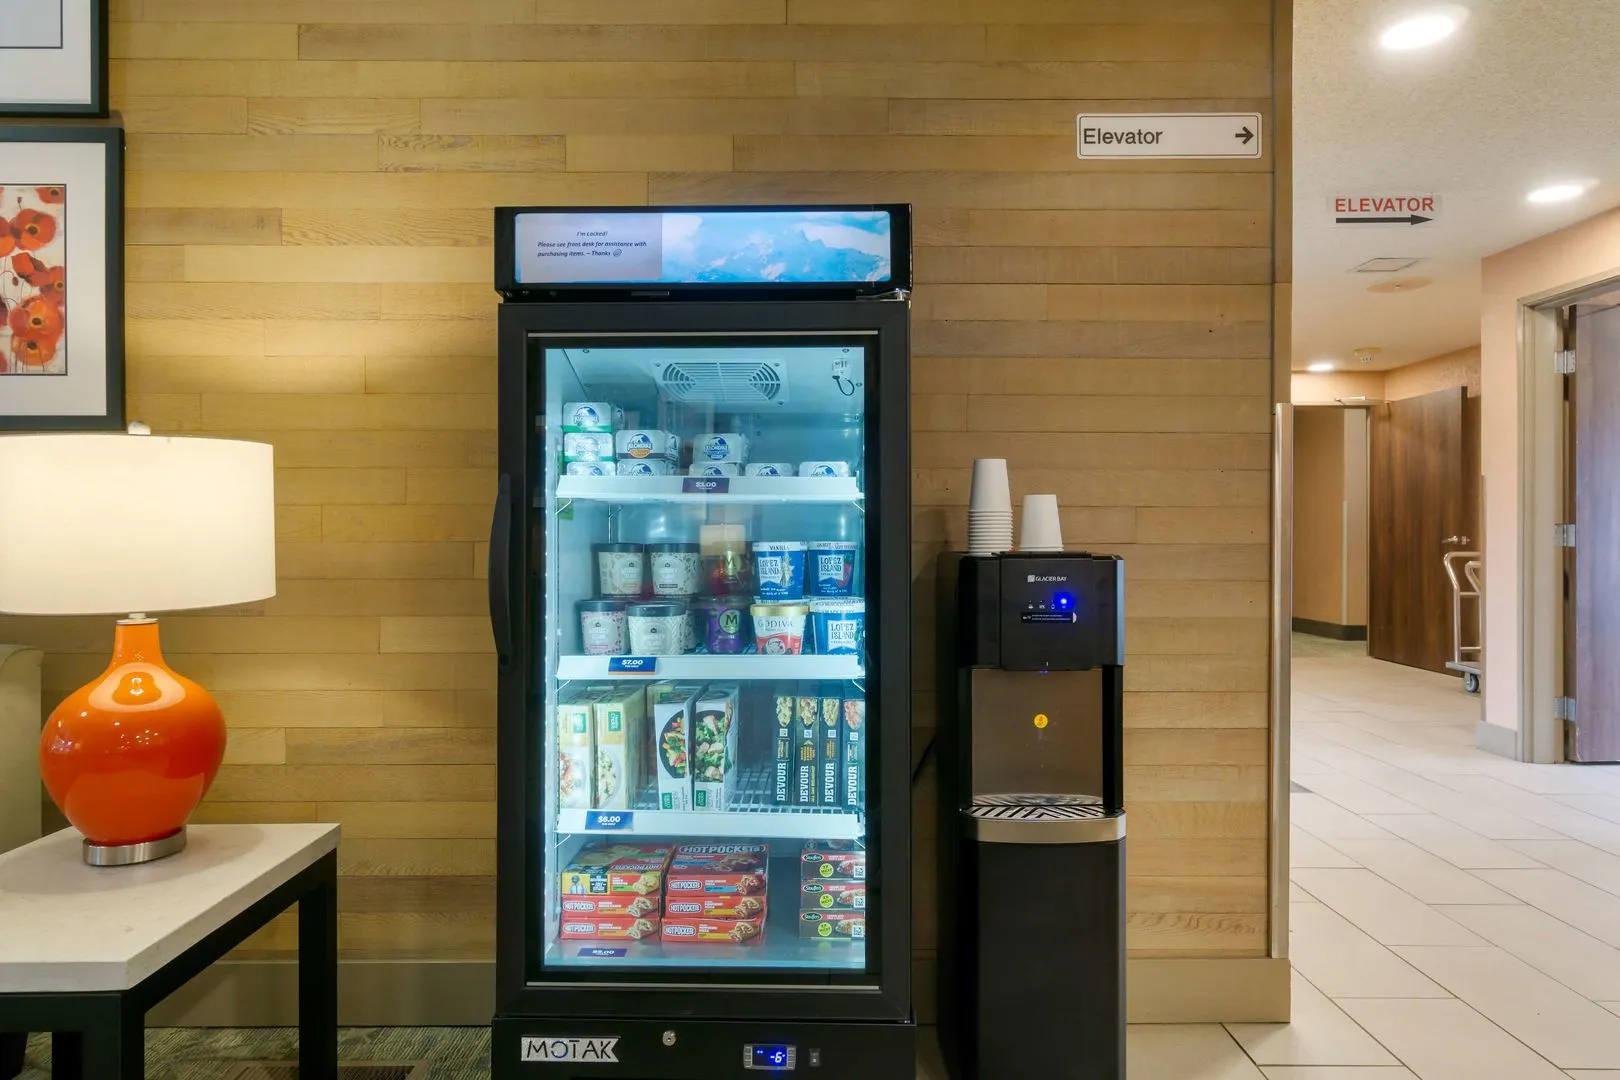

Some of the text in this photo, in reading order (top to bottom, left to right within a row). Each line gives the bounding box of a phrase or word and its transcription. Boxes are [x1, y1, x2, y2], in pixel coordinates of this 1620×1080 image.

[1083, 128, 1163, 145] Elevator
[1335, 197, 1434, 212] ELEVATOR
[566, 241, 581, 249] front
[595, 241, 604, 249] for
[537, 251, 568, 259] purchasing
[820, 564, 842, 572] ISLAND
[776, 761, 787, 801] DEVOUR
[800, 765, 809, 802] DEVOUR
[824, 762, 835, 802] DEVOUR
[847, 765, 858, 806] DEVOUR
[597, 815, 621, 823] $6.00
[527, 1039, 611, 1059] MOTAK
